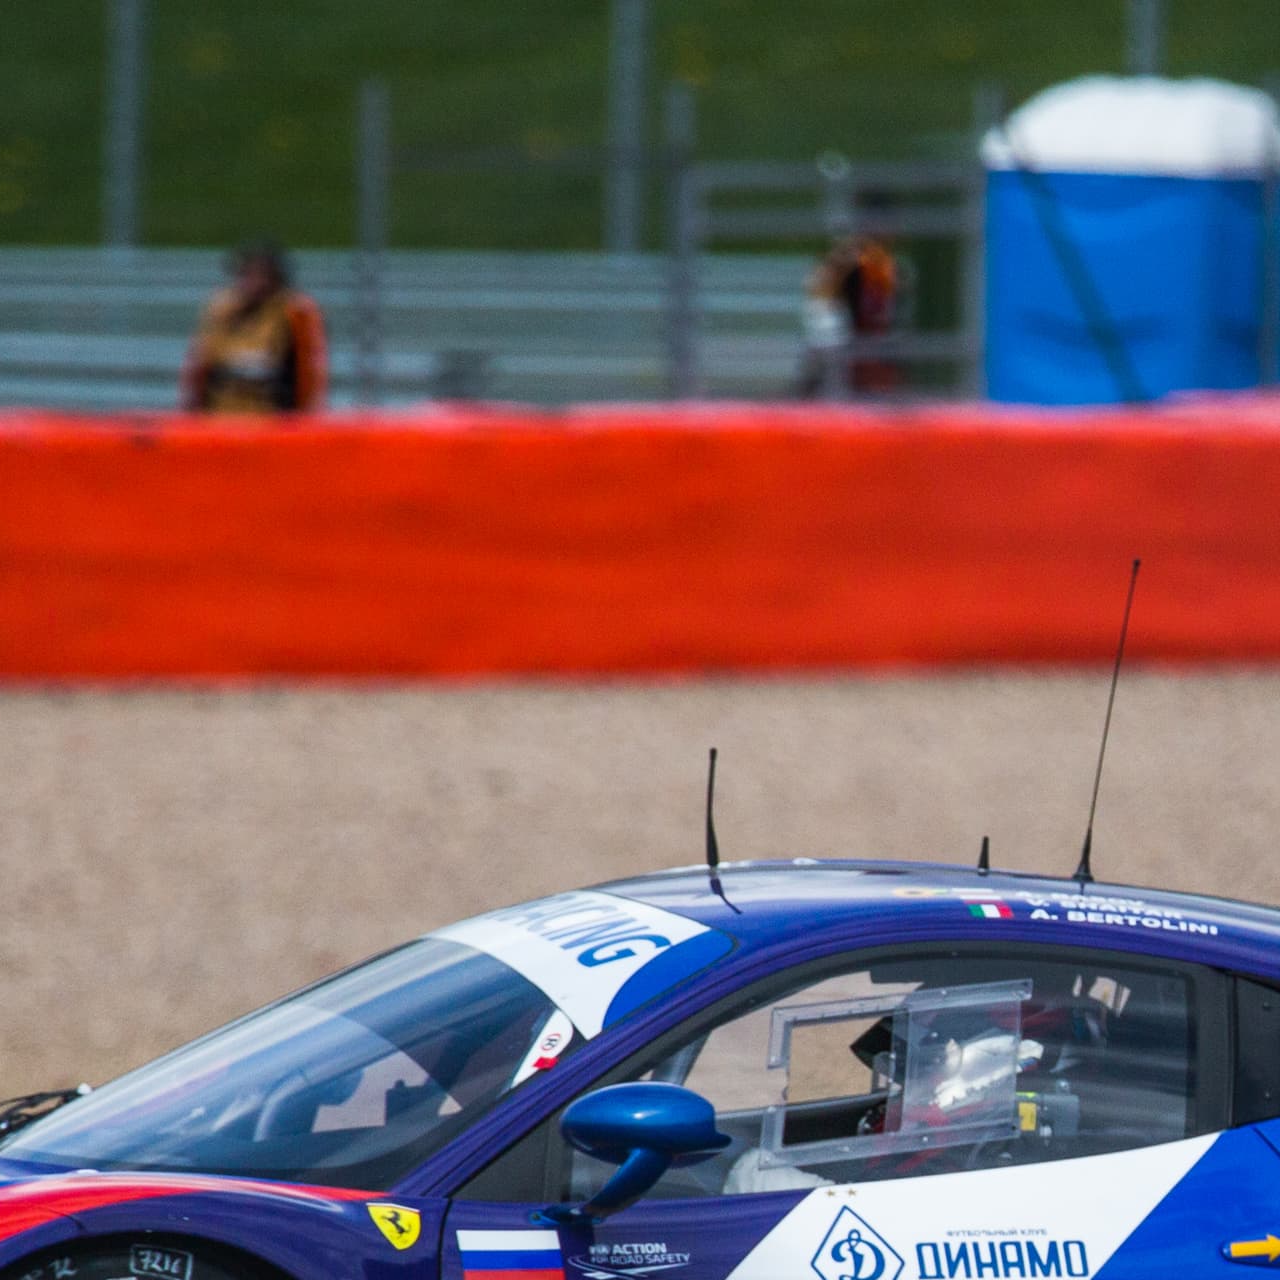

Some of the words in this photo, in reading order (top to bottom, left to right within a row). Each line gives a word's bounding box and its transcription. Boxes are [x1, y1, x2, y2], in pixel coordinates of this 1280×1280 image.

[1030, 909, 1058, 920] A.
[1066, 911, 1219, 936] BERTOLINI
[612, 1242, 667, 1255] ACTION
[610, 1254, 644, 1265] ROAD
[644, 1253, 690, 1265] SAFETY
[915, 1240, 1089, 1280] ДИНАМО
